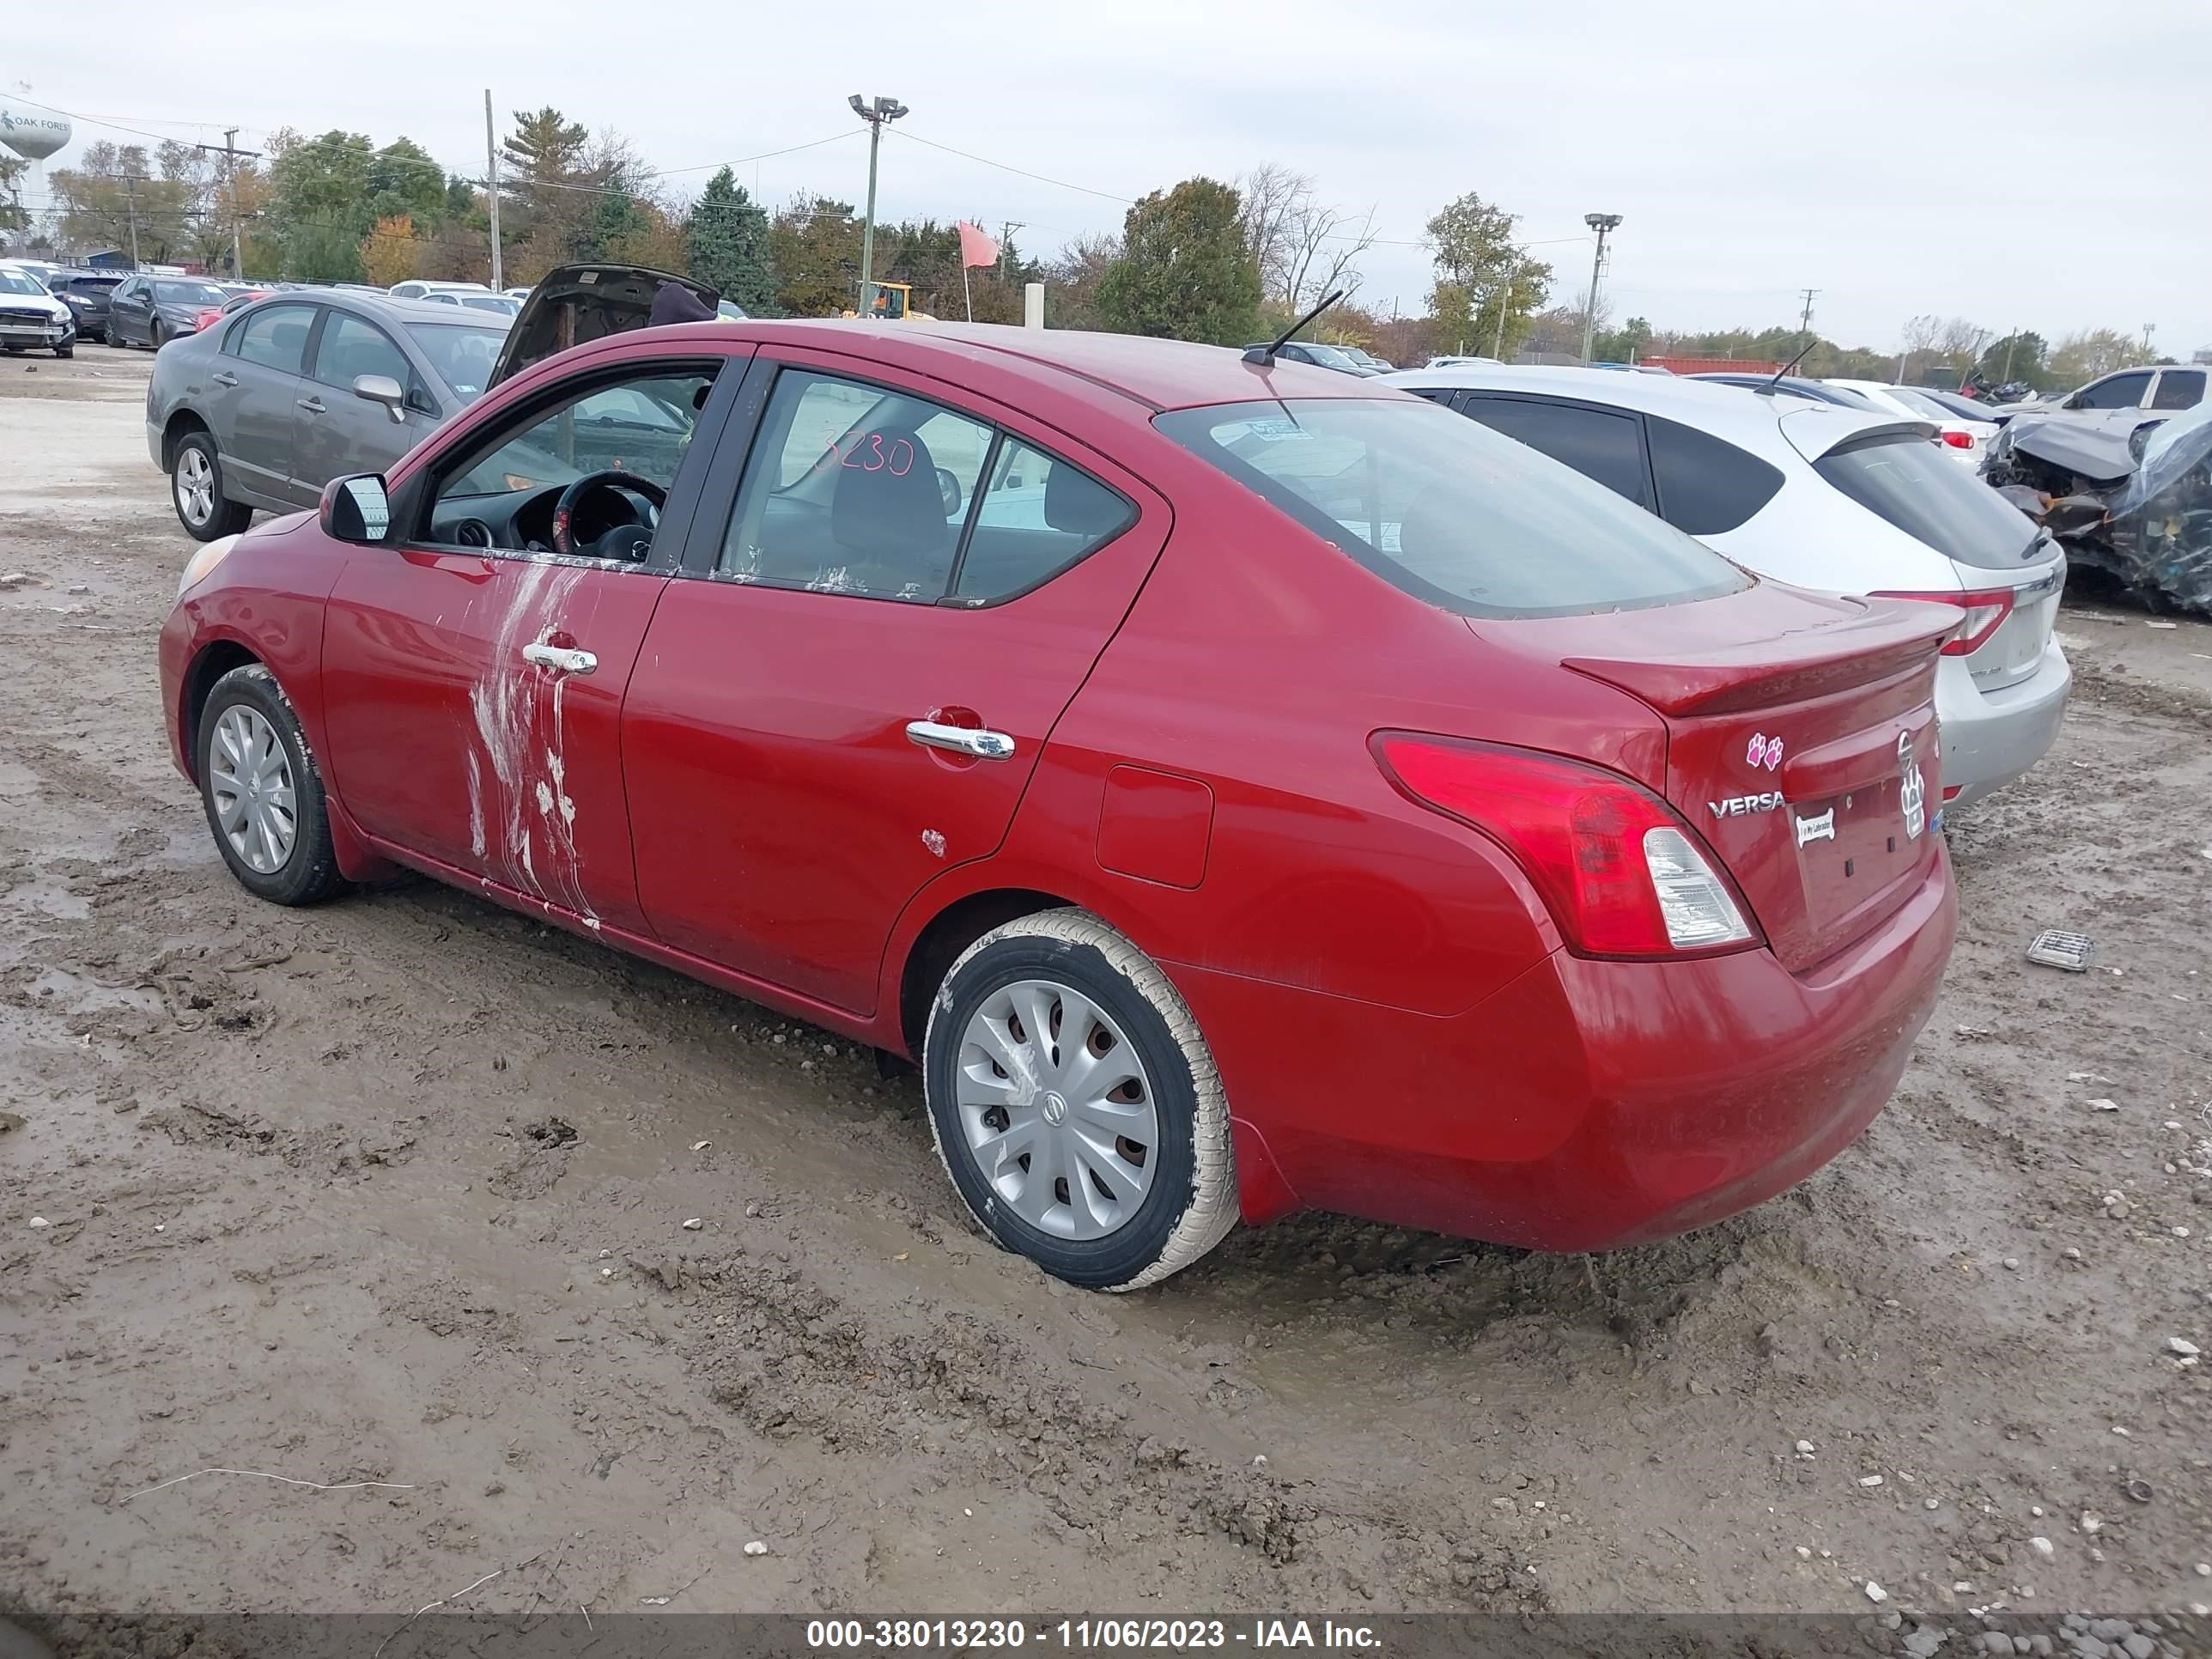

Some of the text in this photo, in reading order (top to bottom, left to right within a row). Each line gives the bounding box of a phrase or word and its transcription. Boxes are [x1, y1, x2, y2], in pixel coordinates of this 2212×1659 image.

[15, 117, 38, 127] OAK
[814, 428, 915, 477] 3230
[1707, 790, 1786, 819] VERSA
